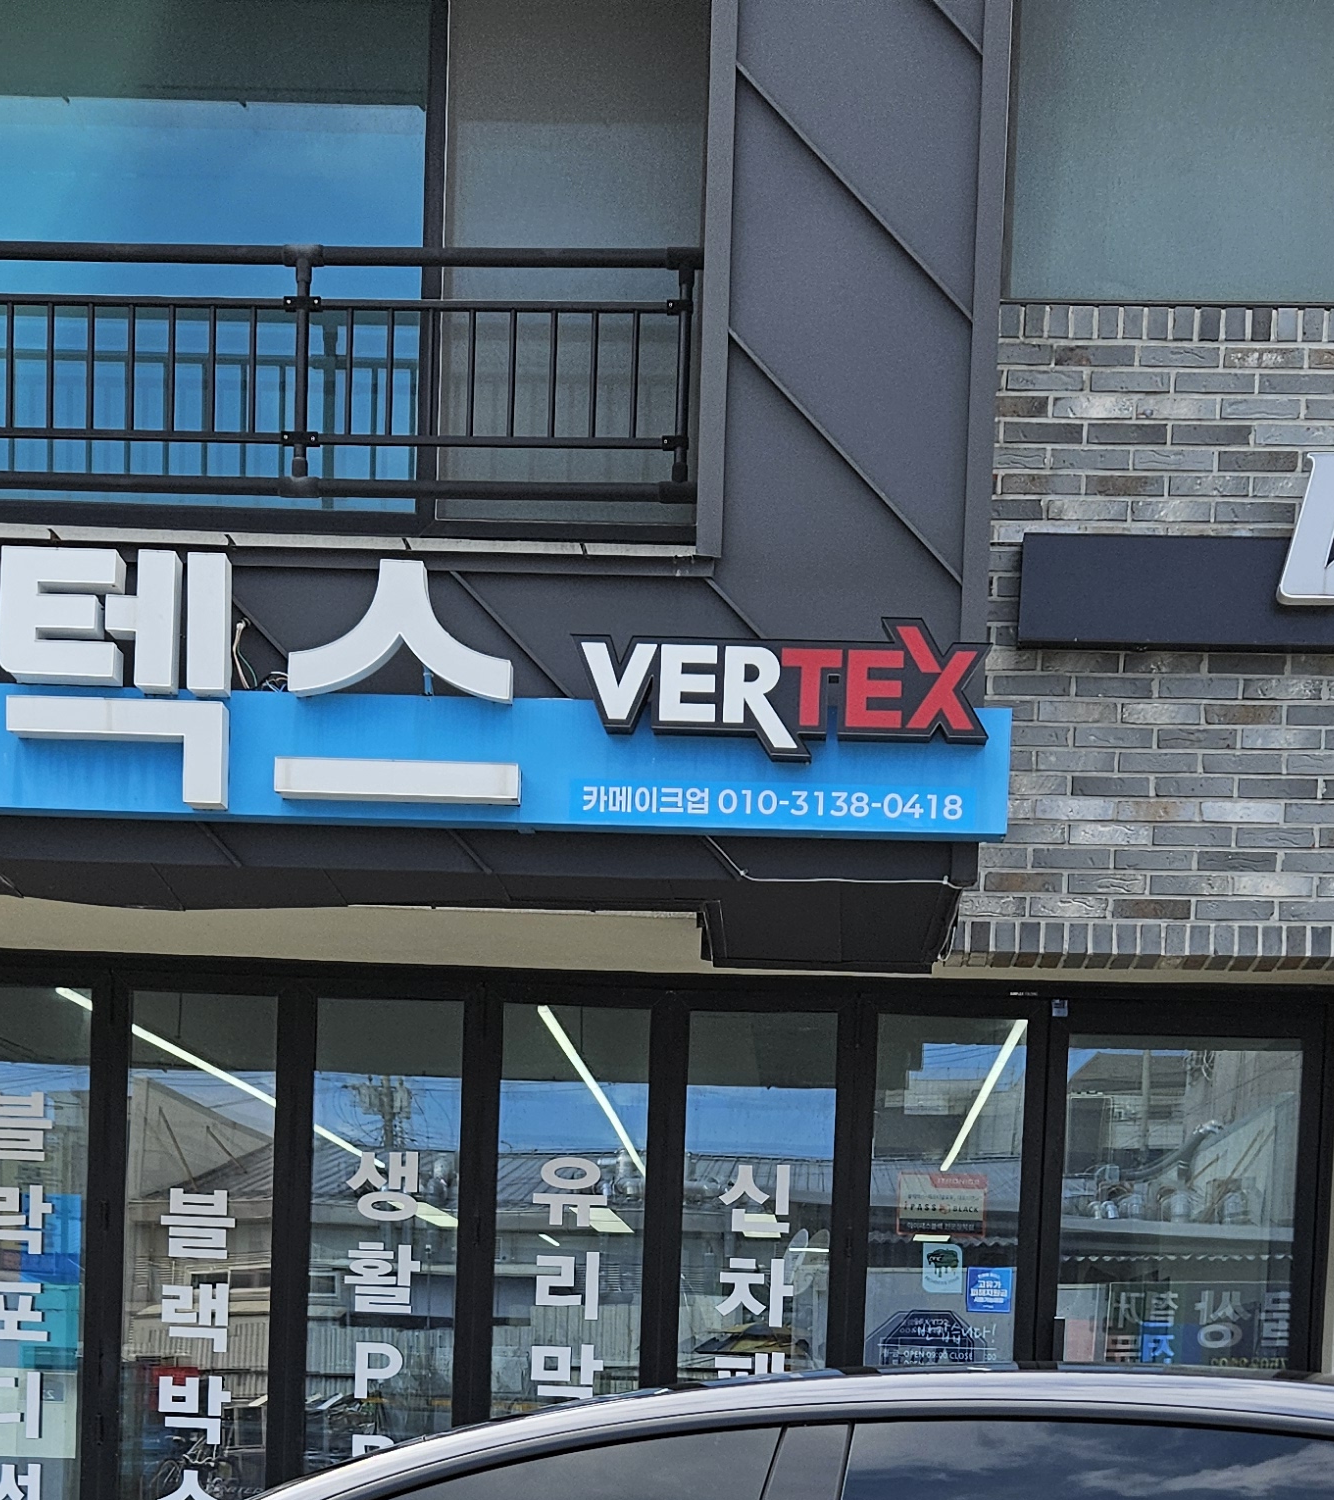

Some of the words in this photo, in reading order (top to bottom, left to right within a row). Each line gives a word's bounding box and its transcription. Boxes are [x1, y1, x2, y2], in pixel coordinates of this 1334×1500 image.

[580, 626, 978, 749] VERTEX
[583, 786, 710, 813] 카메이크업
[718, 788, 963, 820] 010-3138-0418
[903, 1350, 925, 1358] OPEN
